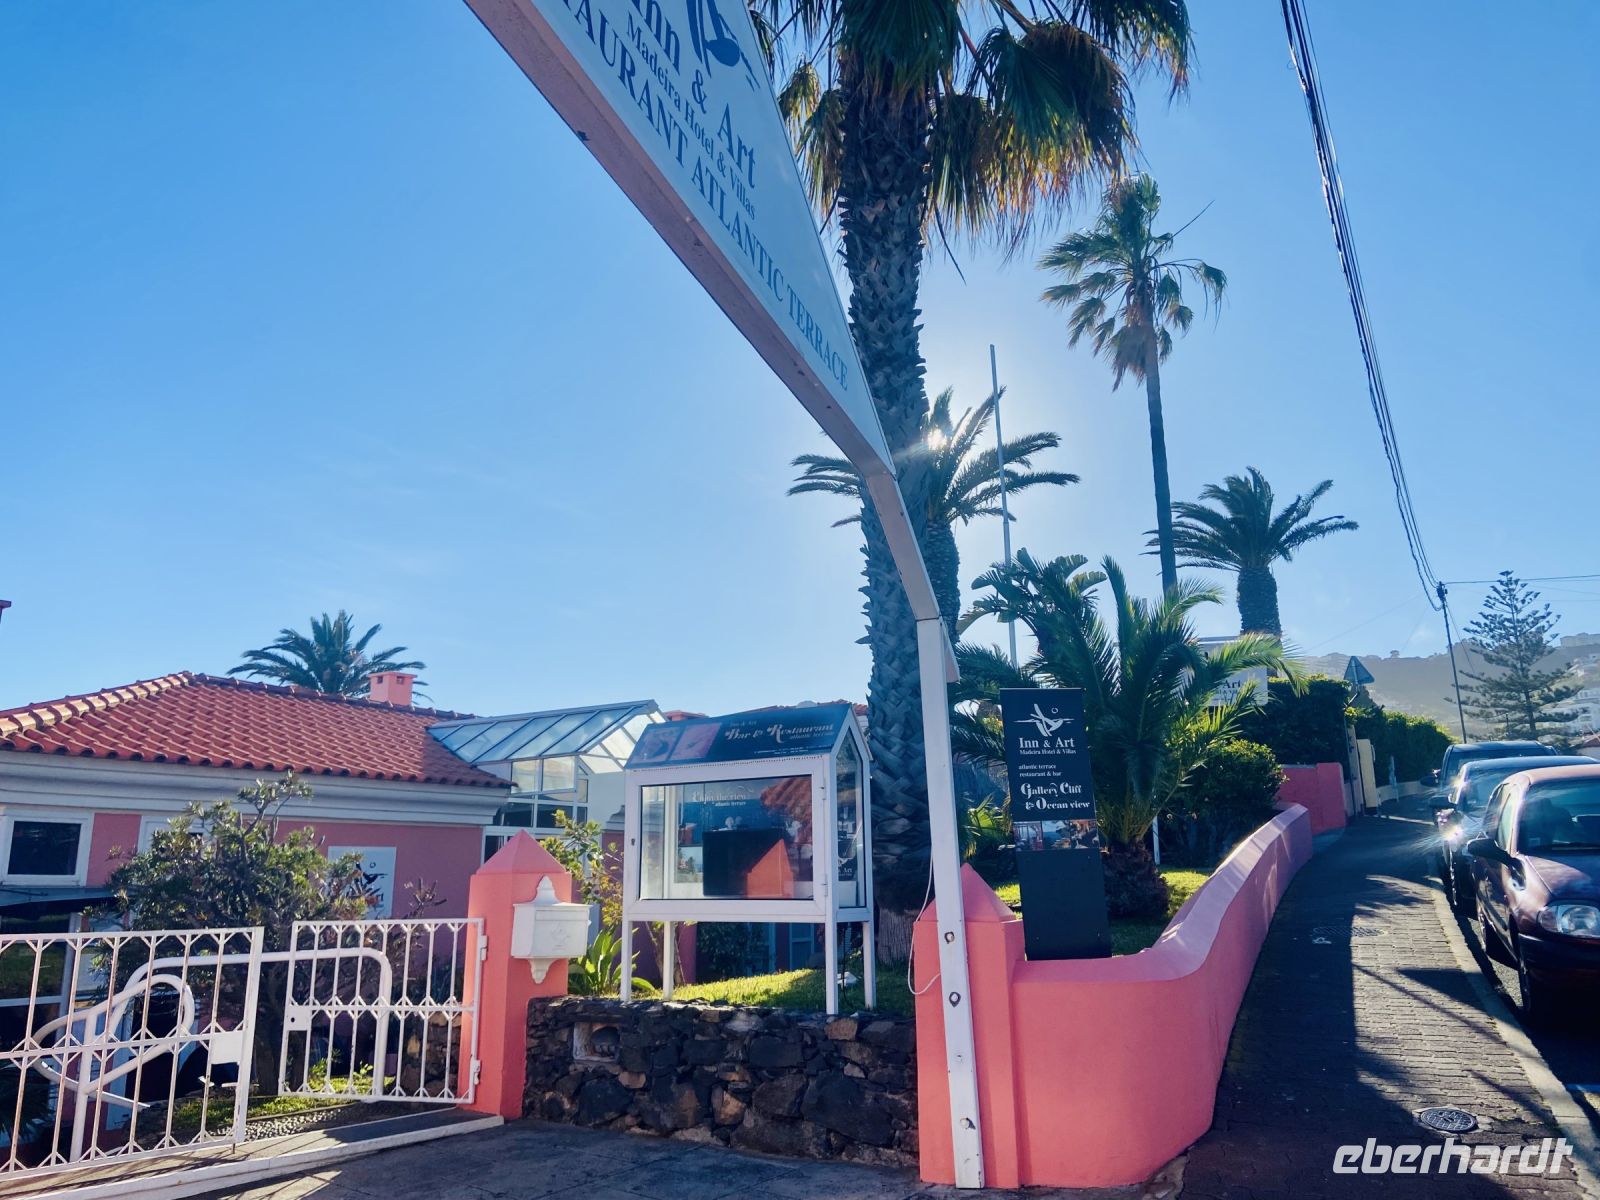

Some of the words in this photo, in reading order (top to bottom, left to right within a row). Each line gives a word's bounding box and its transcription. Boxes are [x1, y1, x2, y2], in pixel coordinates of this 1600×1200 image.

[627, 10, 681, 111] Madeira
[685, 99, 714, 160] Hotel
[717, 152, 727, 178] &
[730, 167, 756, 220] Villas
[632, 0, 681, 76] nn
[691, 69, 707, 114] &
[717, 103, 756, 189] Art
[563, 0, 688, 168] AURANT
[691, 156, 784, 302] ATLANTIC
[787, 284, 849, 391] TERRACE
[1019, 738, 1039, 748] Inn
[1043, 739, 1051, 748] &
[1055, 737, 1075, 748] Art
[1020, 783, 1058, 799] Gallery
[1035, 797, 1068, 810] Ocean
[1069, 800, 1091, 809] view
